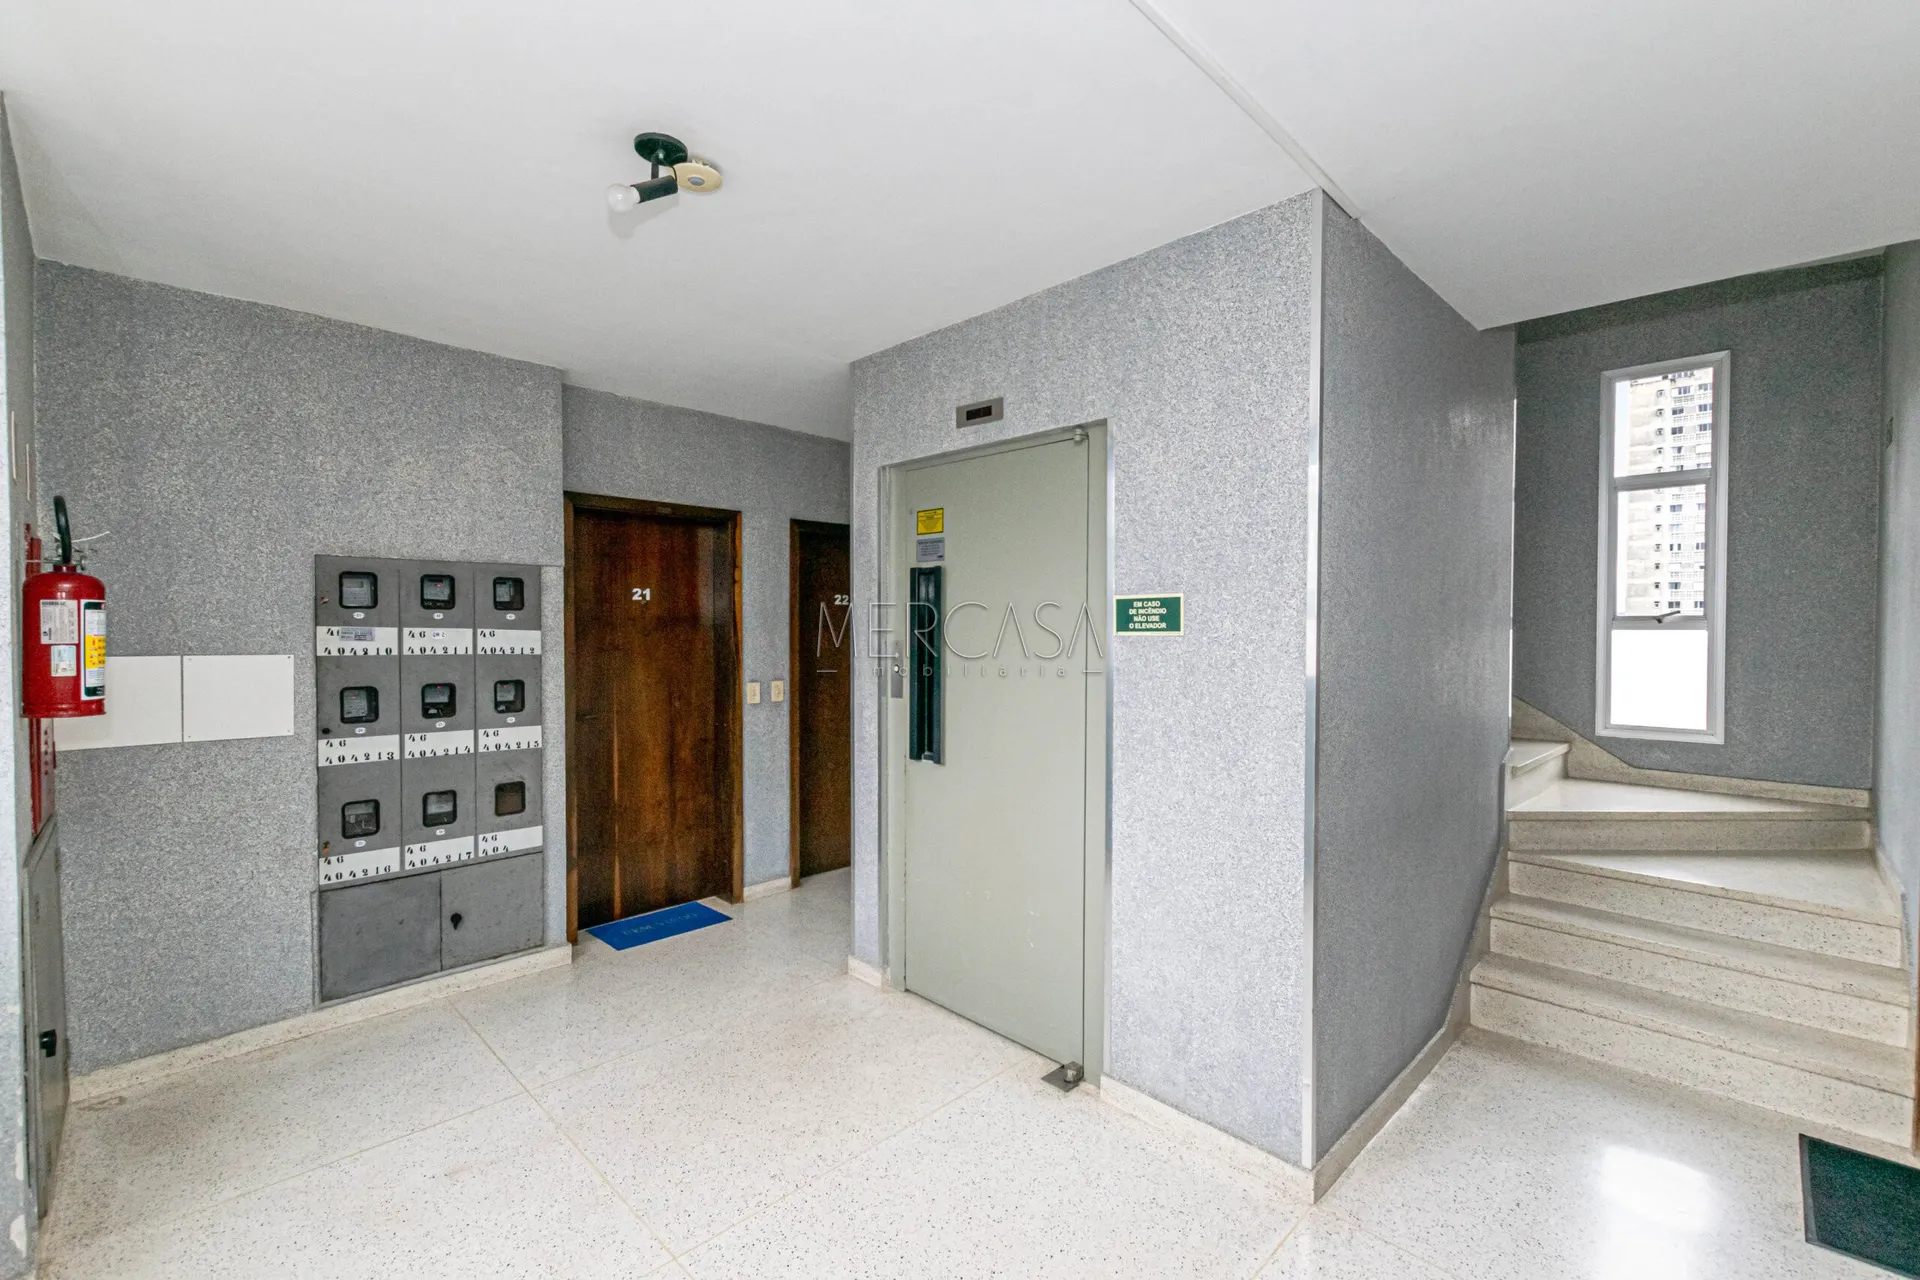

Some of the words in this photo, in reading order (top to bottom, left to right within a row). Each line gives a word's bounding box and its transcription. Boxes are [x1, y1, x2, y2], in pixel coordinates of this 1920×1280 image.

[631, 588, 651, 600] 21
[834, 594, 849, 605] 22
[1138, 606, 1167, 615] INCÊNDIO
[480, 630, 496, 639] 46
